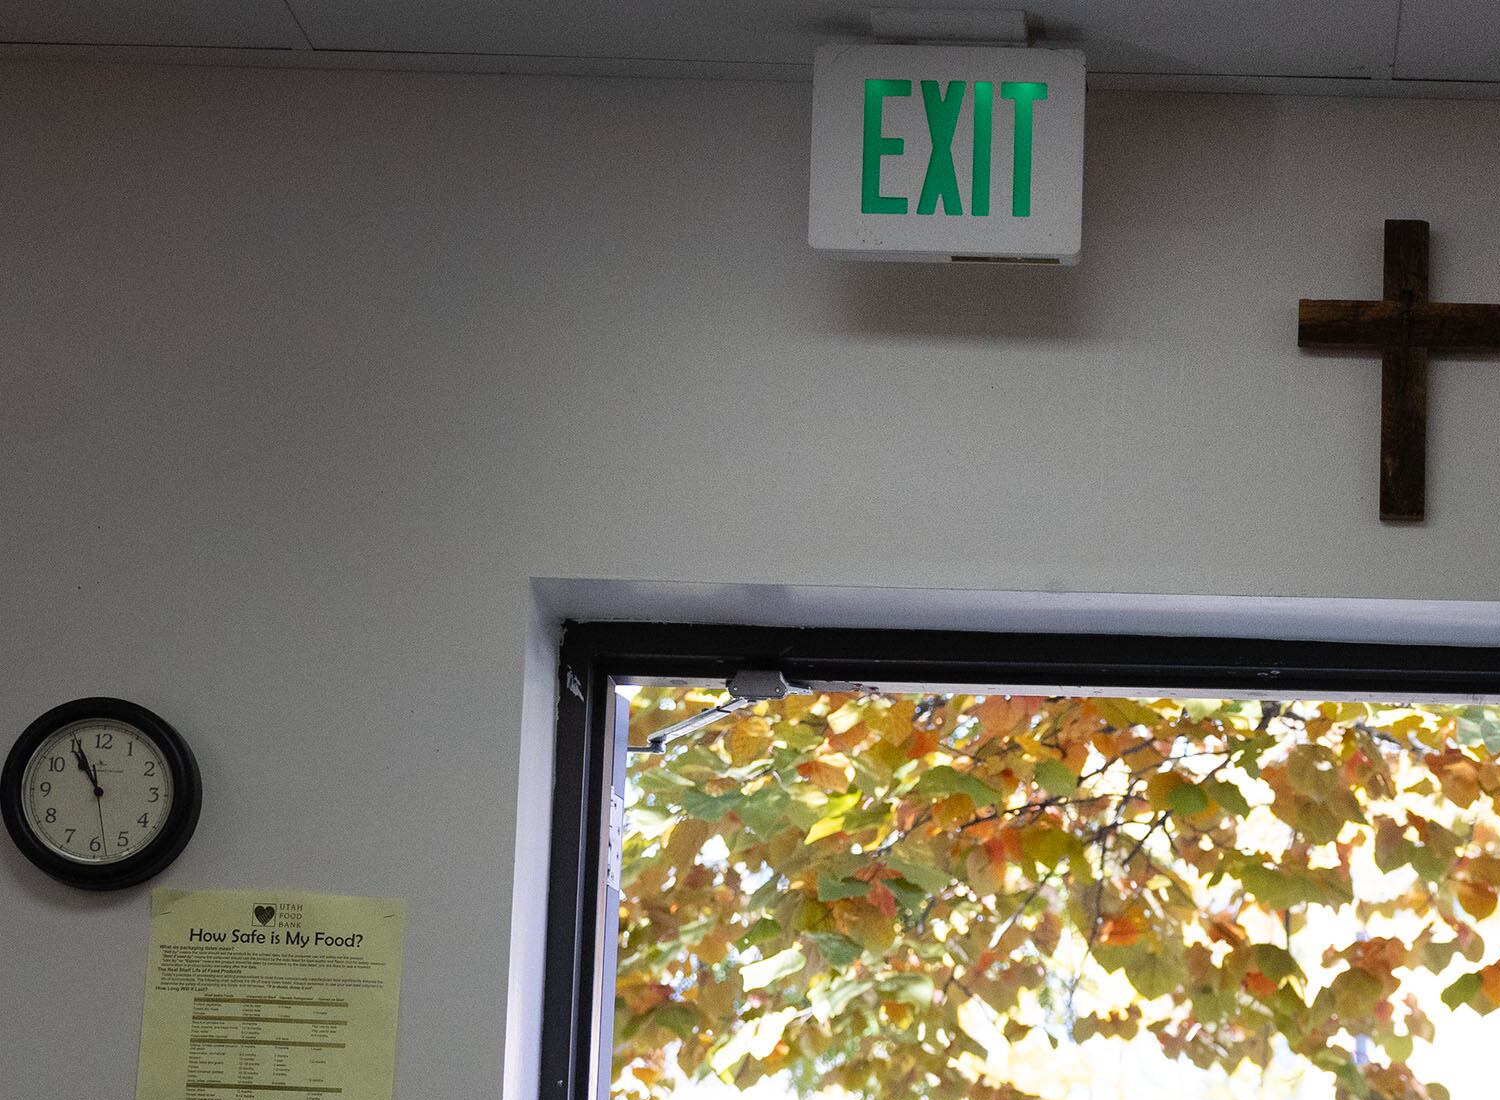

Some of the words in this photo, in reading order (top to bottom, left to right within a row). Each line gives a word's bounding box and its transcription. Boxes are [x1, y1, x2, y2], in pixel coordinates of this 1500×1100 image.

[861, 79, 1048, 217] EXIT
[71, 739, 82, 753] 11
[95, 733, 113, 750] 12
[127, 741, 133, 757] 1
[49, 757, 65, 772] 10
[144, 761, 155, 777] 2
[40, 782, 51, 797] 9
[149, 787, 159, 803] 3
[45, 808, 57, 823] 8
[137, 812, 149, 828] 4
[64, 828, 76, 843] 7
[117, 831, 128, 847] 5
[89, 837, 100, 852] 6
[279, 903, 303, 911] UTAH
[279, 912, 302, 920] FOOD
[189, 928, 227, 942] How
[232, 929, 266, 944] Safe
[271, 931, 280, 944] is
[285, 931, 310, 948] My
[314, 932, 364, 948] Food?
